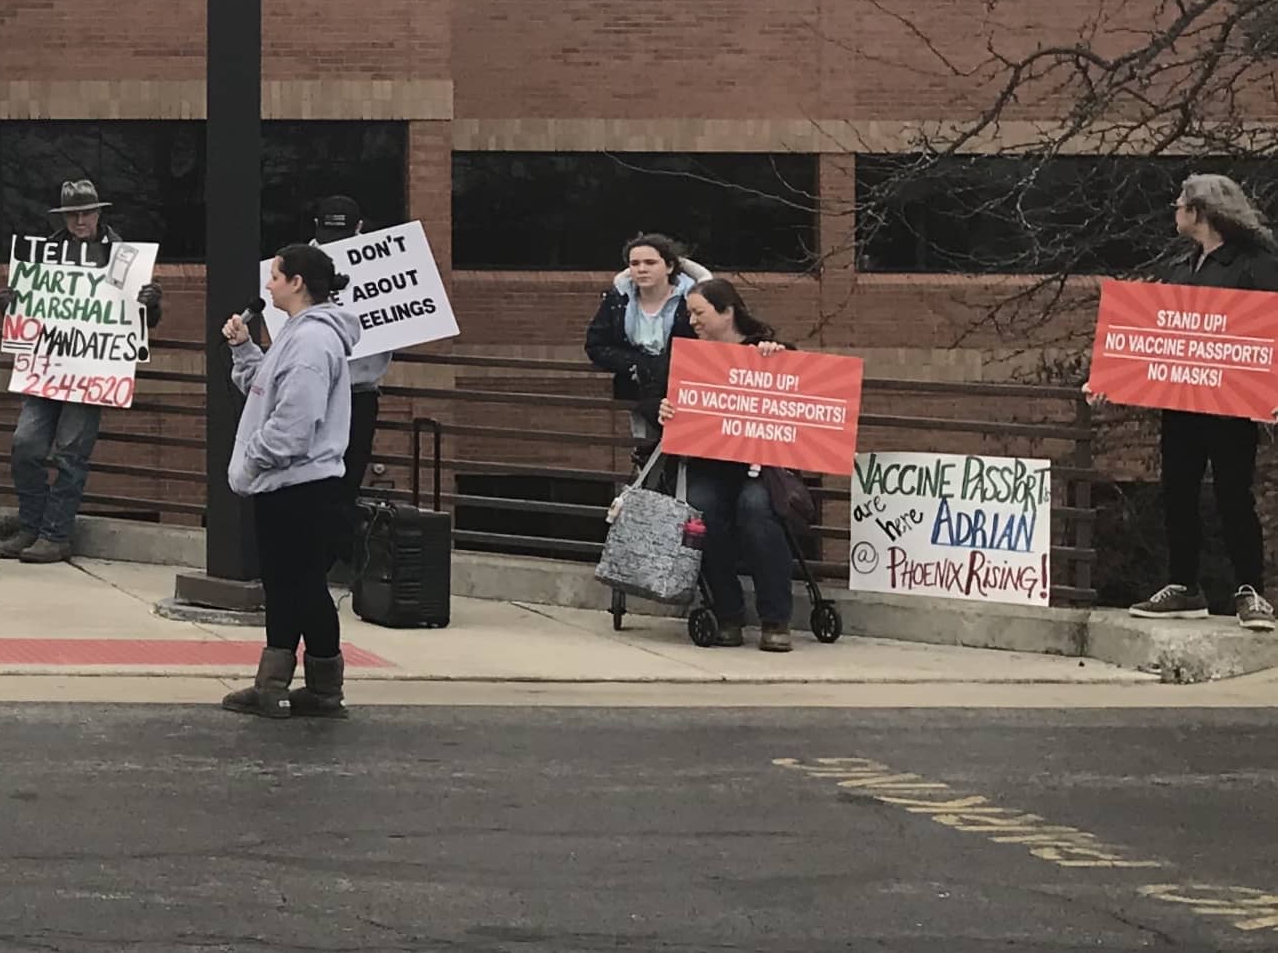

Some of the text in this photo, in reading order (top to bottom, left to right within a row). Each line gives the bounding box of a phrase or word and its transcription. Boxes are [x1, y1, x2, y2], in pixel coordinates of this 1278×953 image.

[24, 236, 97, 266] TELL
[347, 235, 405, 265] DON'T
[11, 262, 105, 296] MARTY
[353, 270, 418, 302] ABOUT
[10, 290, 131, 325] MARSHALL
[359, 298, 436, 330] EELINGS
[1157, 310, 1227, 332] STAND UP!
[3, 307, 148, 361] NO MANDATES!
[1105, 333, 1273, 365] NO VACCINE PASSPORTS!
[729, 368, 799, 391] STAND UP!
[1148, 363, 1222, 387] NO MASKS!
[678, 388, 846, 423] NO VACCINE PASSPORTS!
[722, 419, 796, 443] NO MASKS!
[854, 453, 956, 498] VACCINE
[853, 496, 886, 522] are
[876, 509, 923, 541] here
[931, 497, 1036, 551] ADRIAN
[851, 541, 879, 574] @
[886, 546, 963, 593] PHOENIX
